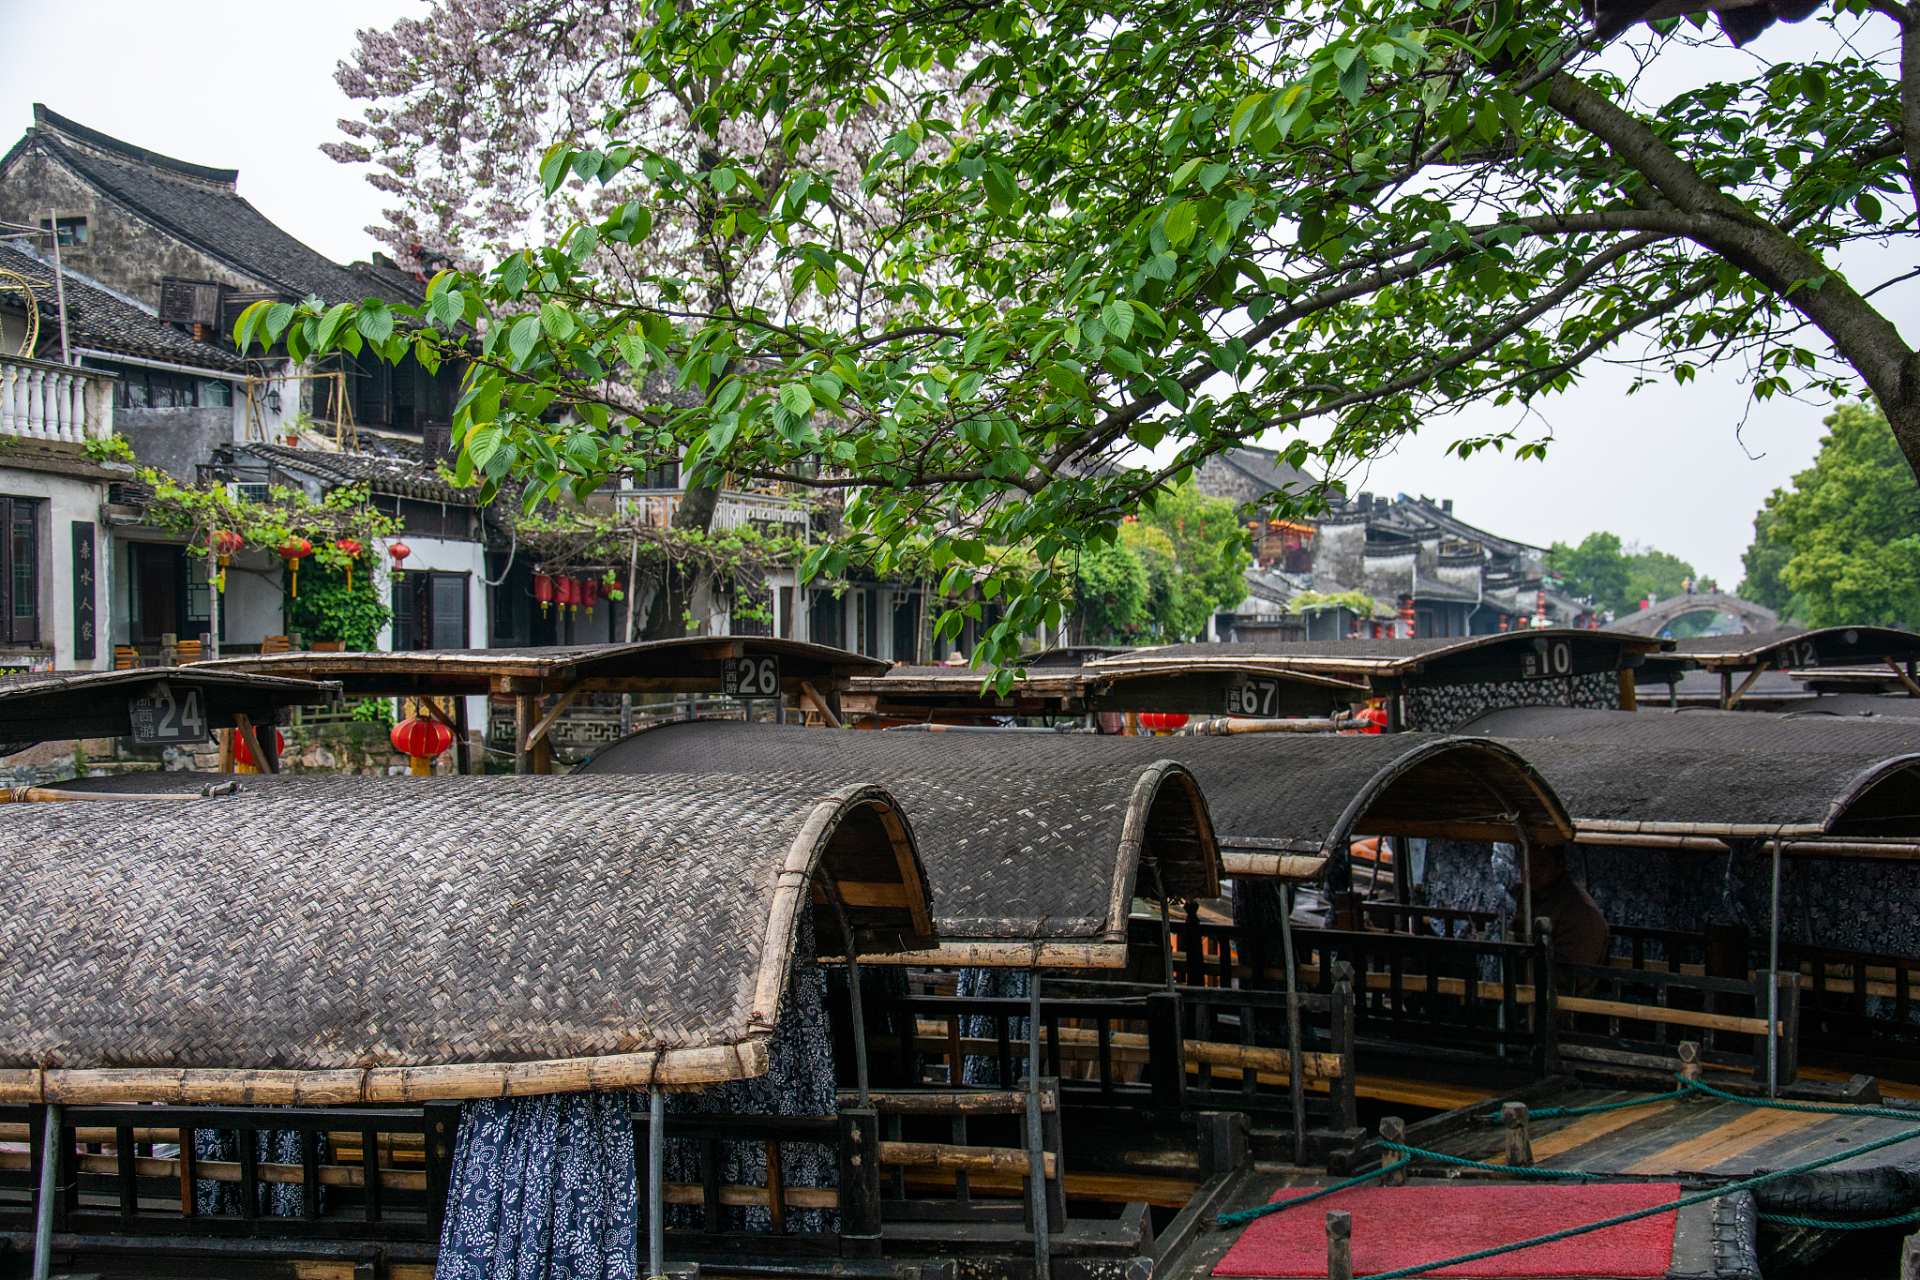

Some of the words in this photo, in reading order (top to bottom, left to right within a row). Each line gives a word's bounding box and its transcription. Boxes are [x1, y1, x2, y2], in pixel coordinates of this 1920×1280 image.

[1541, 643, 1570, 674] 10
[1789, 642, 1816, 666] 12
[739, 658, 776, 694] 26
[155, 690, 203, 737] 24
[1241, 680, 1276, 715] 67
